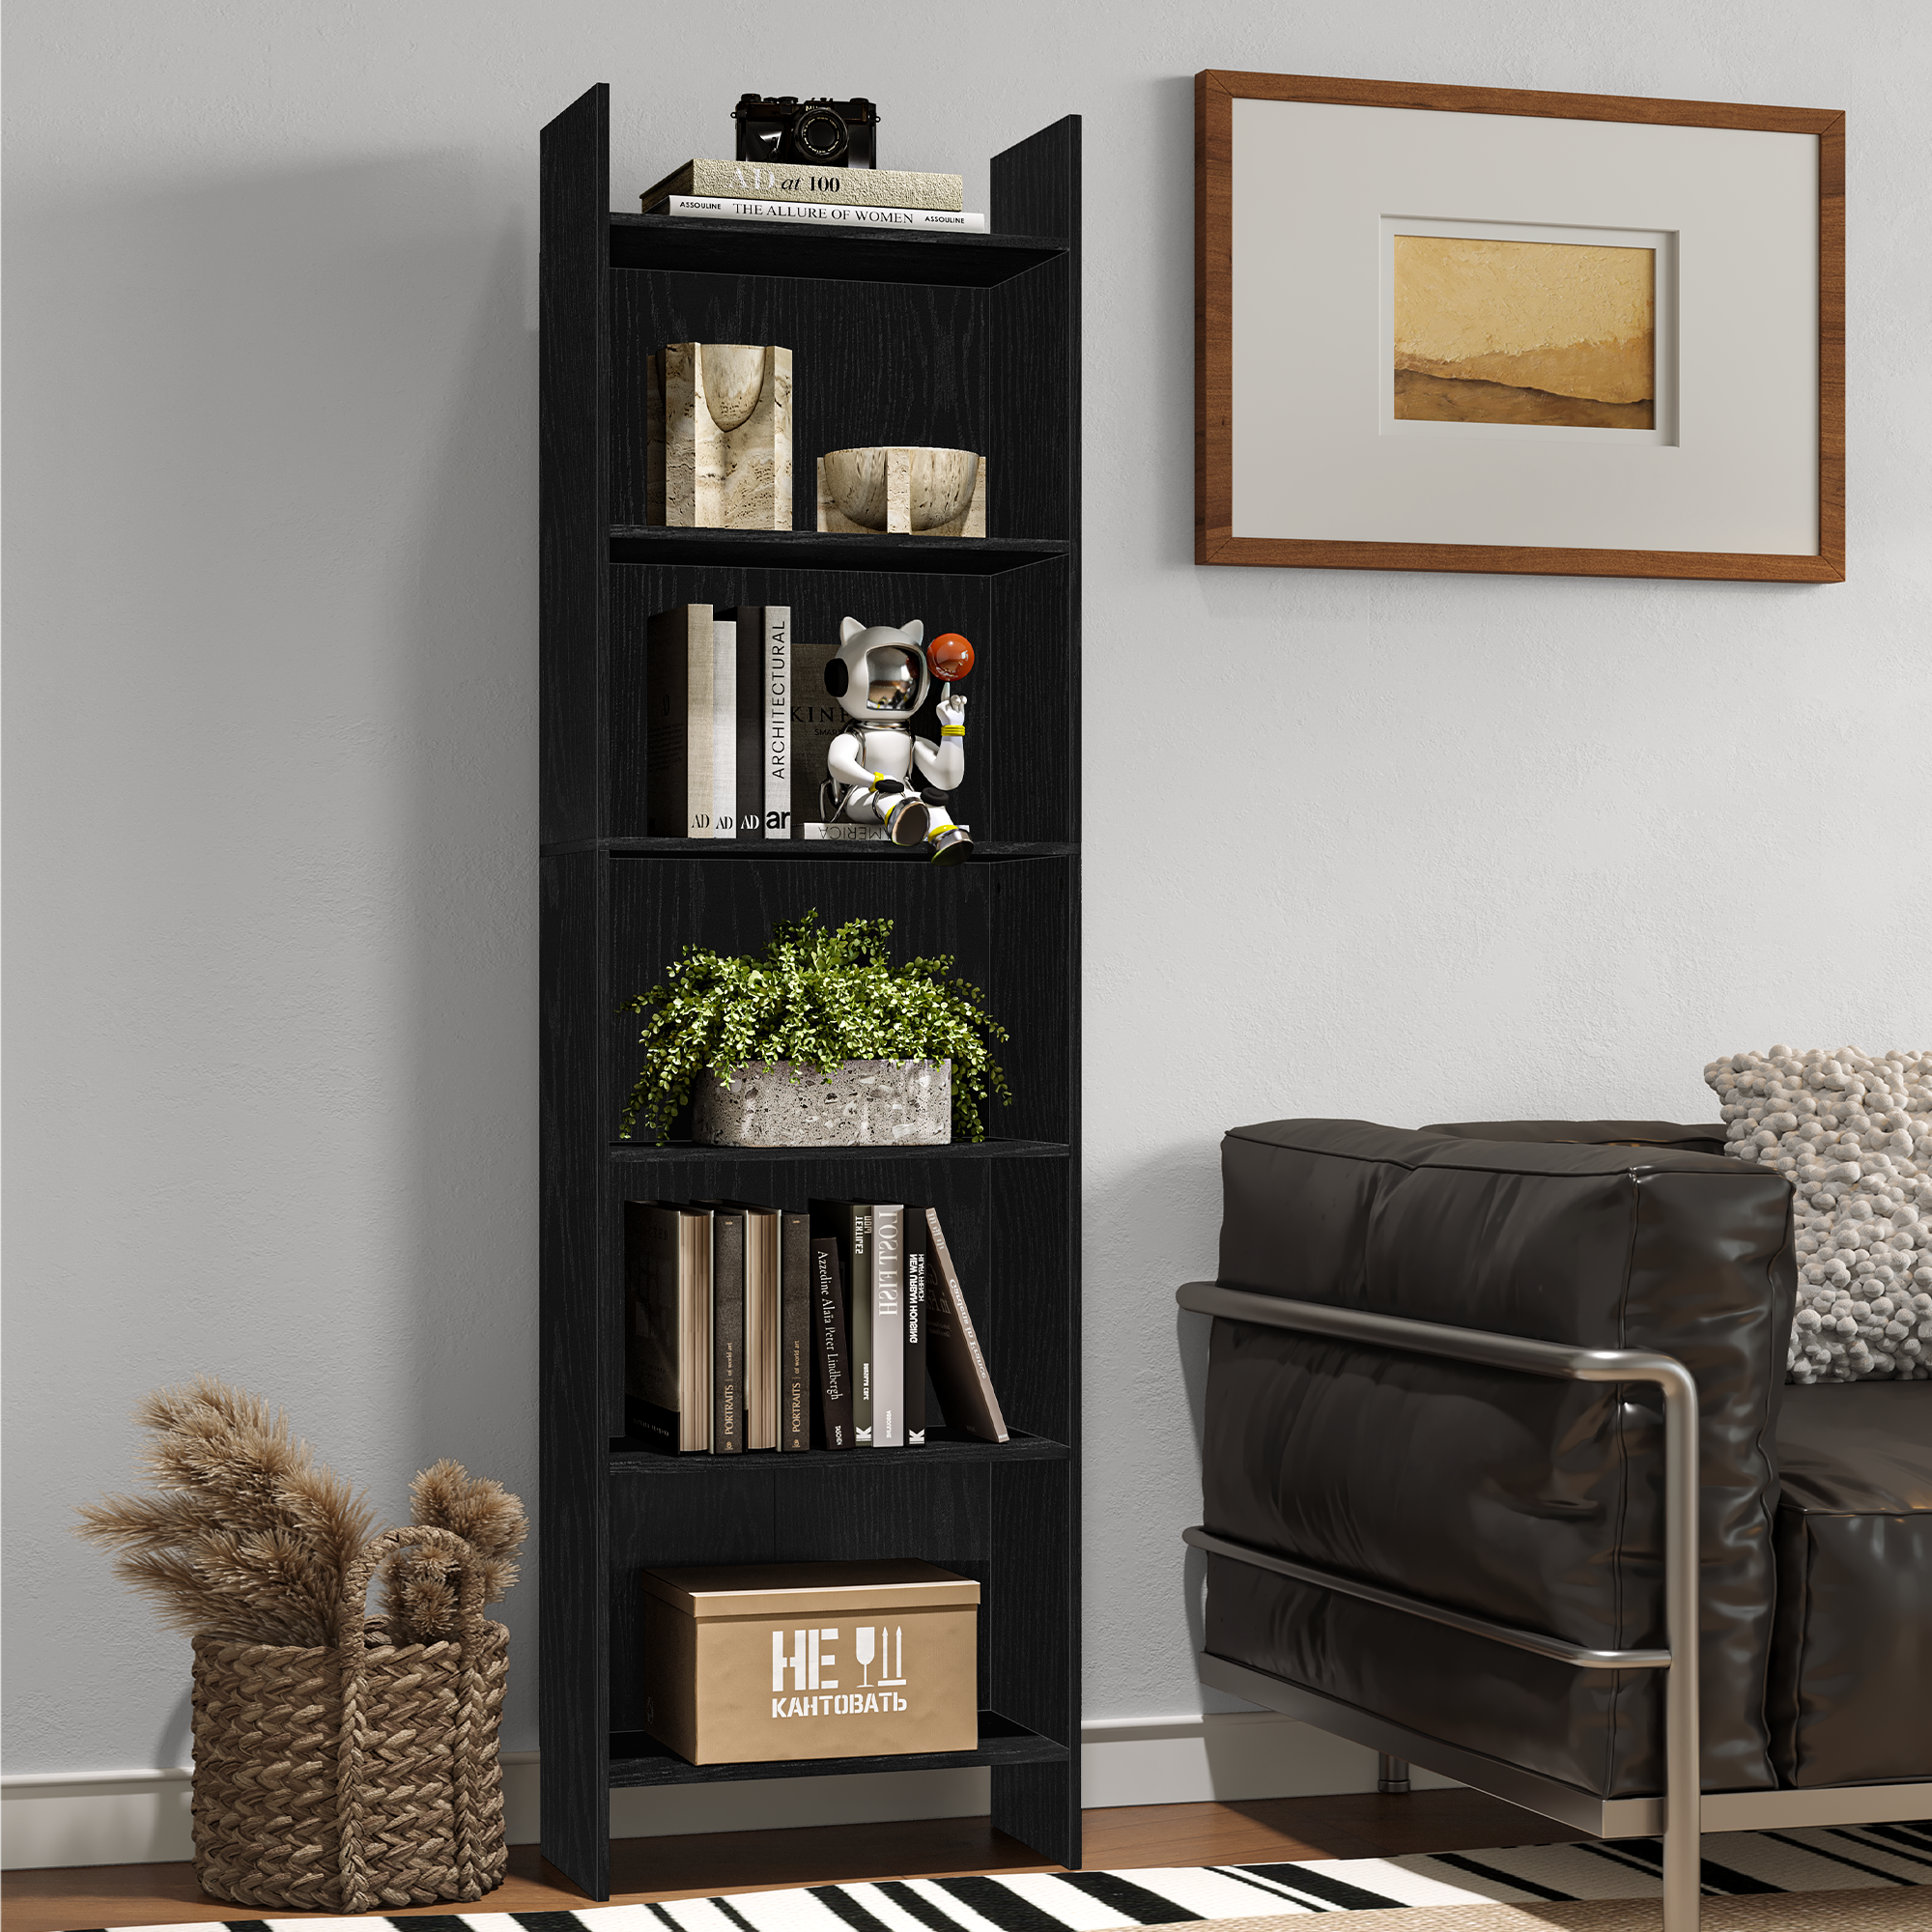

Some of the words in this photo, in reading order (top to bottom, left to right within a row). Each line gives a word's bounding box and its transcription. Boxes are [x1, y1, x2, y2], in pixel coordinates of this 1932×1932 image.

[728, 167, 776, 190] AD
[781, 177, 802, 191] at
[810, 176, 840, 193] 100
[679, 201, 722, 211] ASSOULINE
[732, 203, 764, 215] THE
[766, 205, 828, 219] ALLURE
[831, 209, 851, 221] OF
[855, 211, 914, 224] WOMEN
[924, 215, 965, 224] ASSOULINE
[771, 620, 785, 780] ARCHITECTURAL
[790, 706, 849, 723] KINF
[691, 813, 710, 829] AD
[715, 815, 734, 830] AD
[740, 814, 760, 830] AD
[766, 810, 790, 830] ar
[817, 1251, 833, 1295] Azzedine
[825, 1325, 836, 1351] Peter
[827, 1352, 843, 1401] Lindbergh
[724, 1384, 734, 1435] PORTRAITS
[792, 1382, 801, 1433] PORTRAITS
[835, 1425, 843, 1446] TASCHEN
[772, 1628, 839, 1692] НЕ
[772, 1692, 908, 1719] КАНТОВАТЬ
